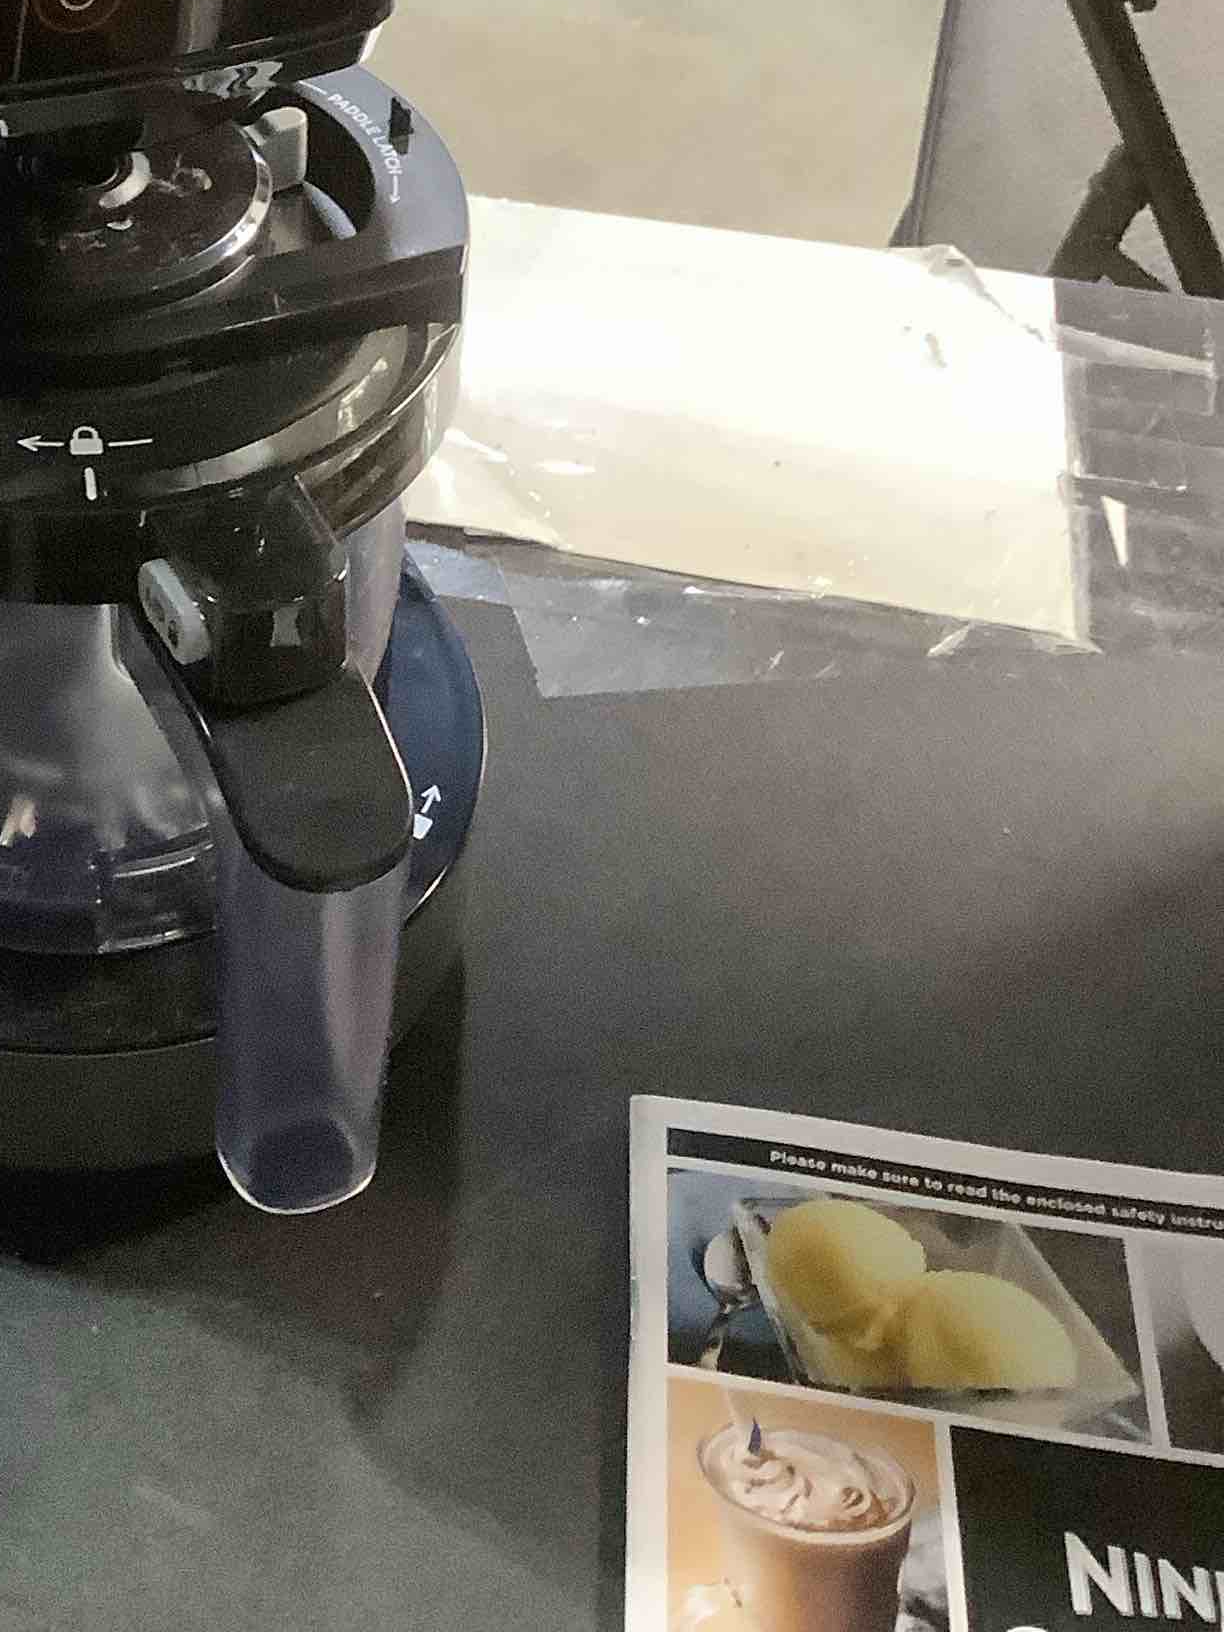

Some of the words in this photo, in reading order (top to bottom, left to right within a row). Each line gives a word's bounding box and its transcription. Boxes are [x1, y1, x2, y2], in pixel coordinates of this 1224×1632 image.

[327, 93, 382, 136] PADDLE
[769, 1150, 826, 1172] Please
[831, 1161, 878, 1181] make
[882, 1171, 920, 1187] sure
[924, 1176, 944, 1192] to
[947, 1182, 988, 1199] read
[991, 1188, 1021, 1205] the
[1026, 1194, 1105, 1216] enclosed
[1111, 1207, 1166, 1226] safety
[1063, 1530, 1224, 1630] NIN
